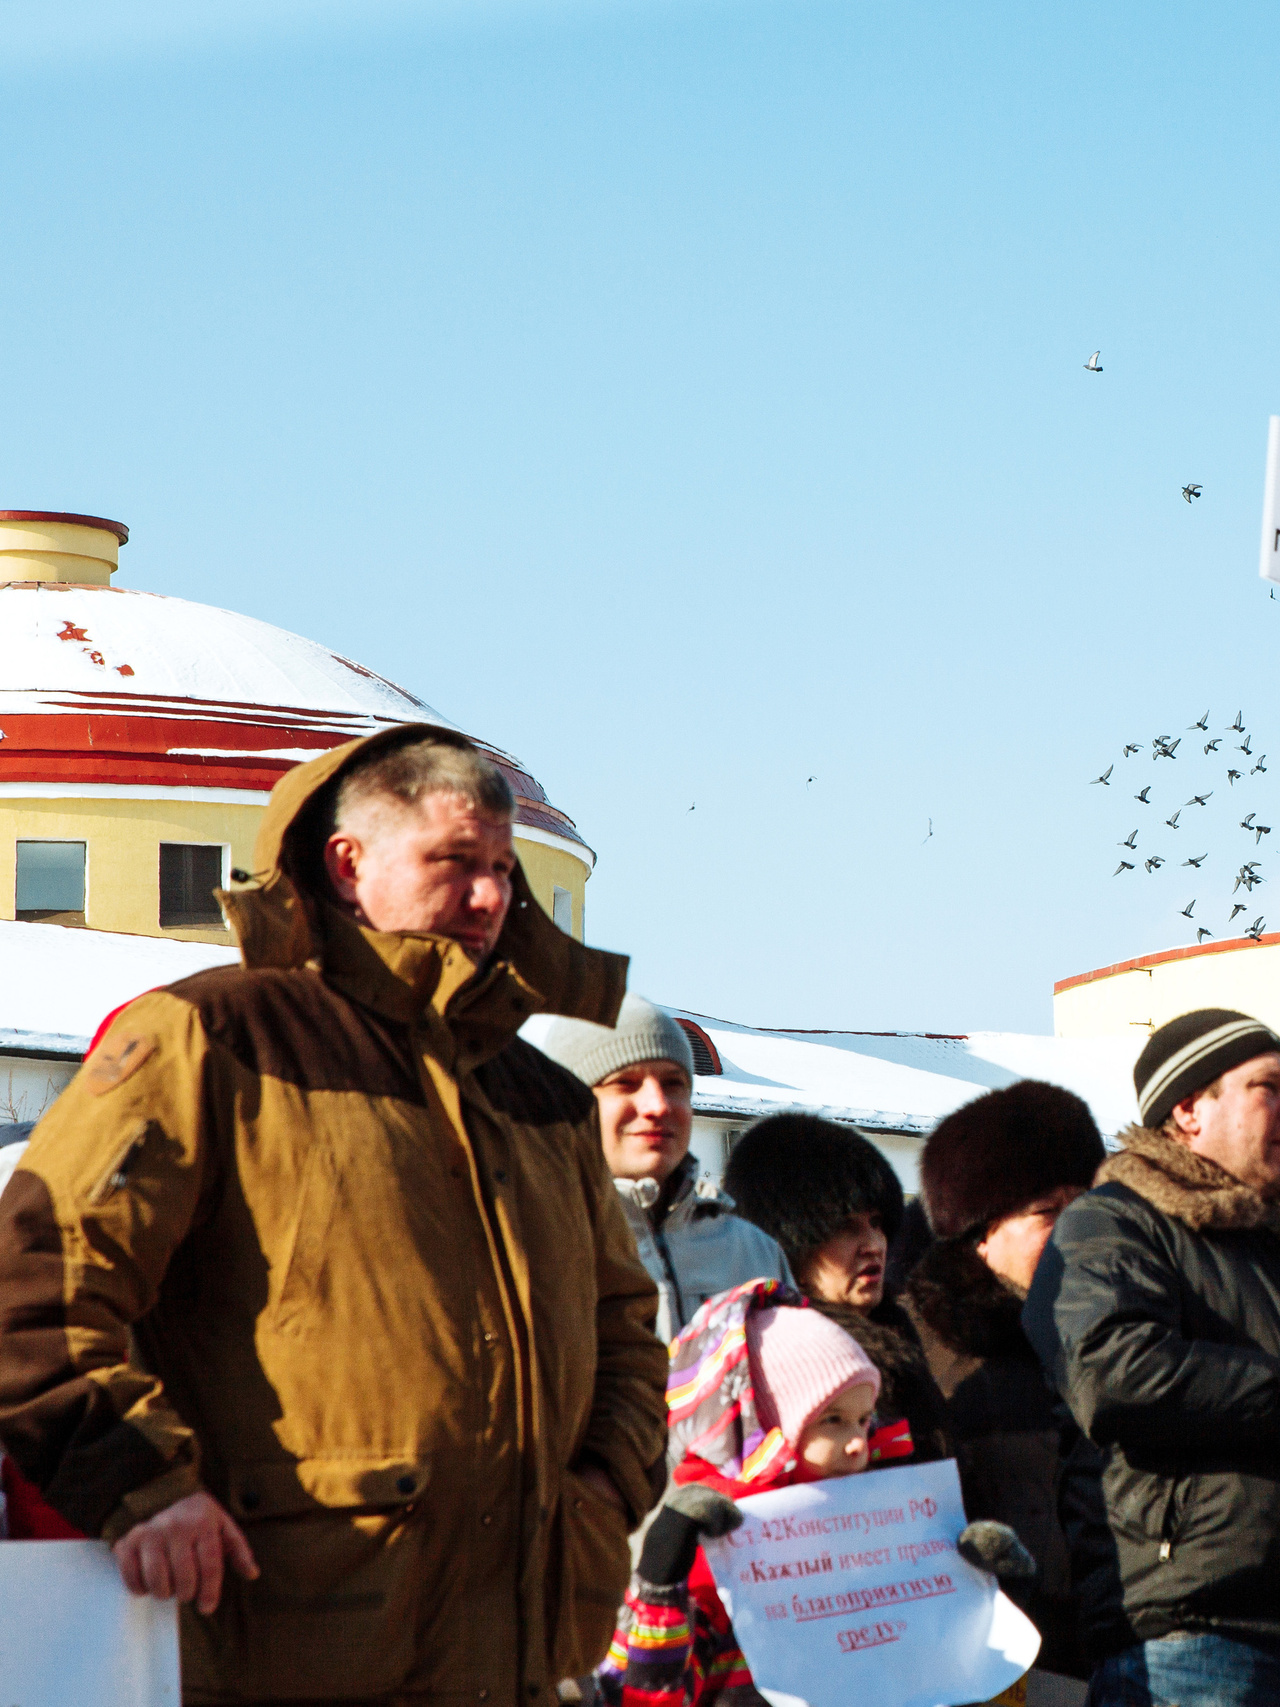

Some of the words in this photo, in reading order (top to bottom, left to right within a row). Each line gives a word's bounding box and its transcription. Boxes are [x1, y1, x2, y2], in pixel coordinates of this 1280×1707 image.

[908, 1497, 938, 1521] РФ
[838, 1547, 891, 1570] имеет
[791, 1573, 954, 1616] благоприятную
